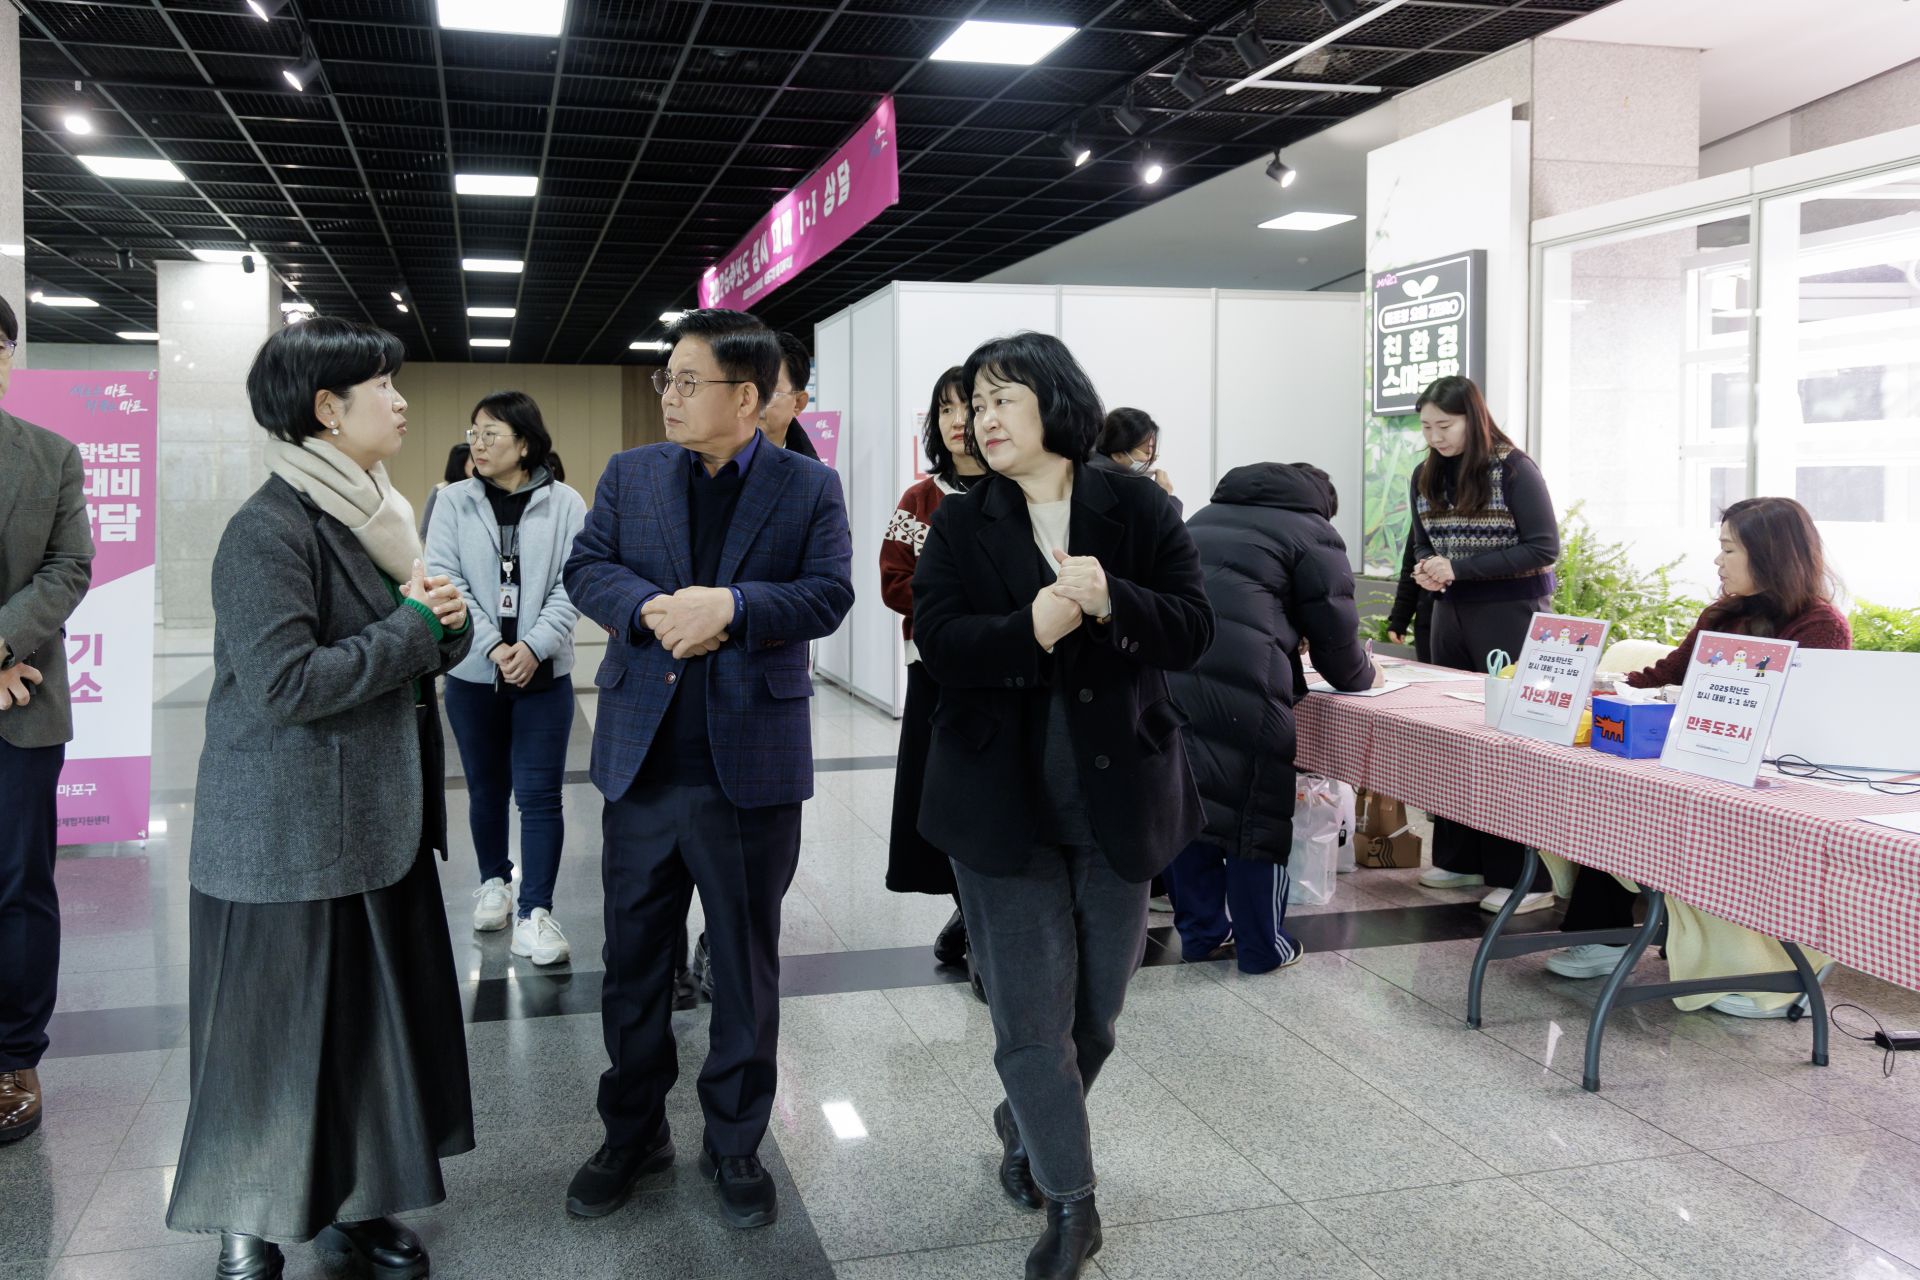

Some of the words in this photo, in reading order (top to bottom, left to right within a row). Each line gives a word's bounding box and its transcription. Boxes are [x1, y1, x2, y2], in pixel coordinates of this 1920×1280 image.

[798, 189, 817, 236] 1:1
[823, 159, 850, 217] 상담
[104, 384, 133, 398] 마포
[119, 400, 148, 415] 마포
[82, 468, 140, 497] 대비
[1539, 654, 1574, 666] 2025학년도
[1709, 683, 1750, 696] 2025학년도
[1520, 685, 1573, 709] 자연계열
[1727, 697, 1740, 706] 1:1
[1743, 699, 1758, 709] 상담
[1686, 715, 1753, 742] 만족도조사
[57, 783, 97, 797] 마포구
